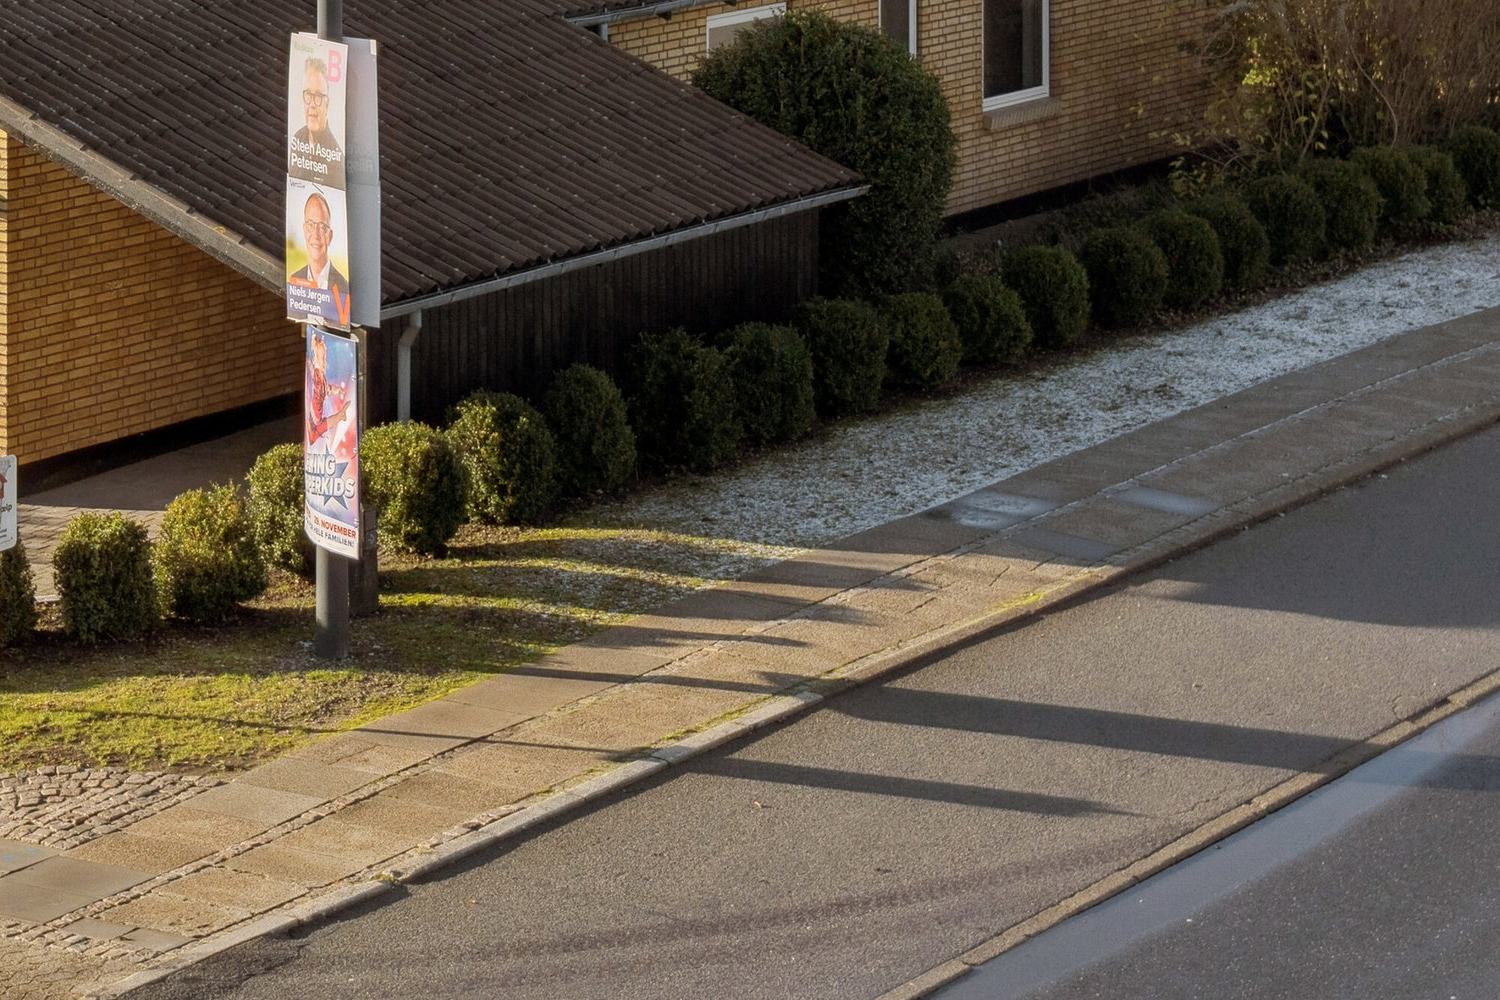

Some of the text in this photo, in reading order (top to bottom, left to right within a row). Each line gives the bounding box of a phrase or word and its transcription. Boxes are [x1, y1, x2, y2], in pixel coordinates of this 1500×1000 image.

[328, 49, 342, 83] B
[291, 136, 315, 155] Steen
[316, 142, 342, 162] Asgeir
[291, 152, 328, 175] Petersen
[290, 285, 306, 297] Niels
[290, 298, 322, 314] Pedersen
[332, 284, 350, 325] V
[321, 519, 357, 539] NOVEMBER
